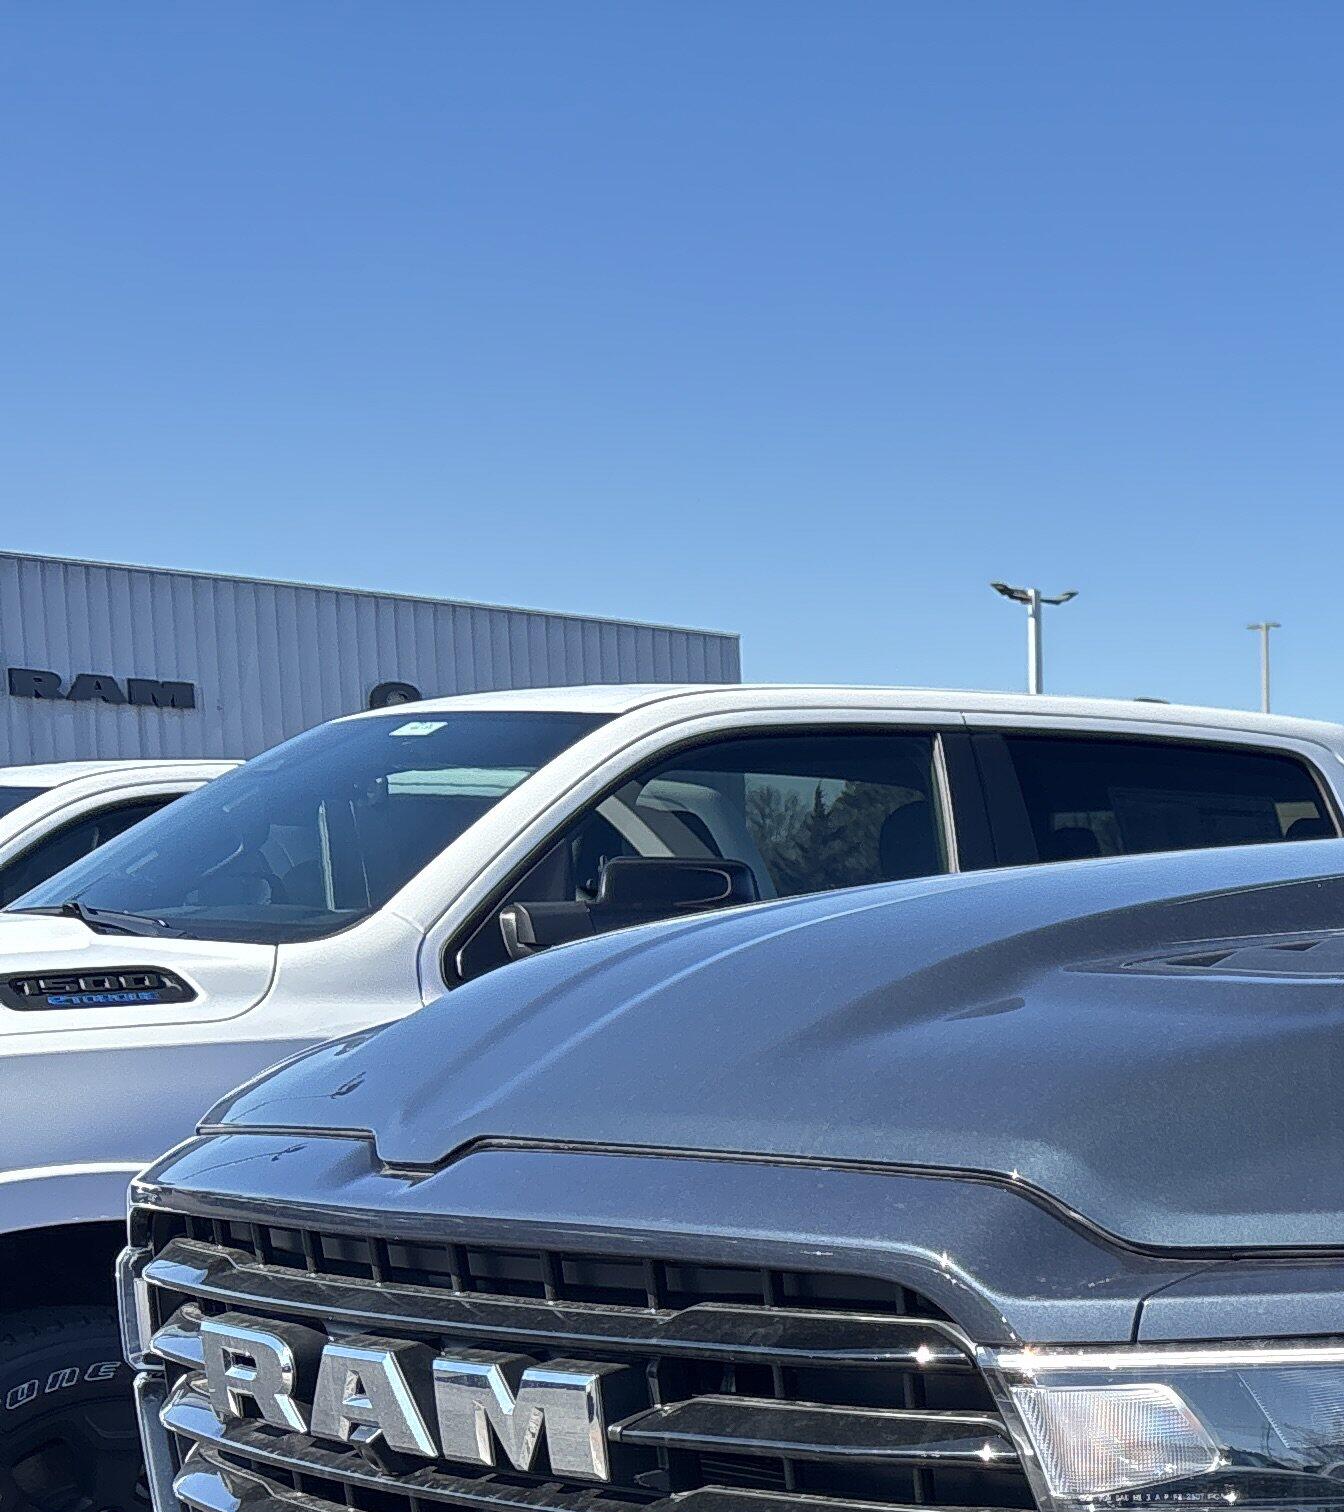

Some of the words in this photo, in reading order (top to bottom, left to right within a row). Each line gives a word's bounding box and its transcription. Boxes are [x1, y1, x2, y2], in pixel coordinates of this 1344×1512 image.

[8, 667, 196, 709] RAM
[17, 974, 161, 996] 1500
[200, 1315, 610, 1483] RAM
